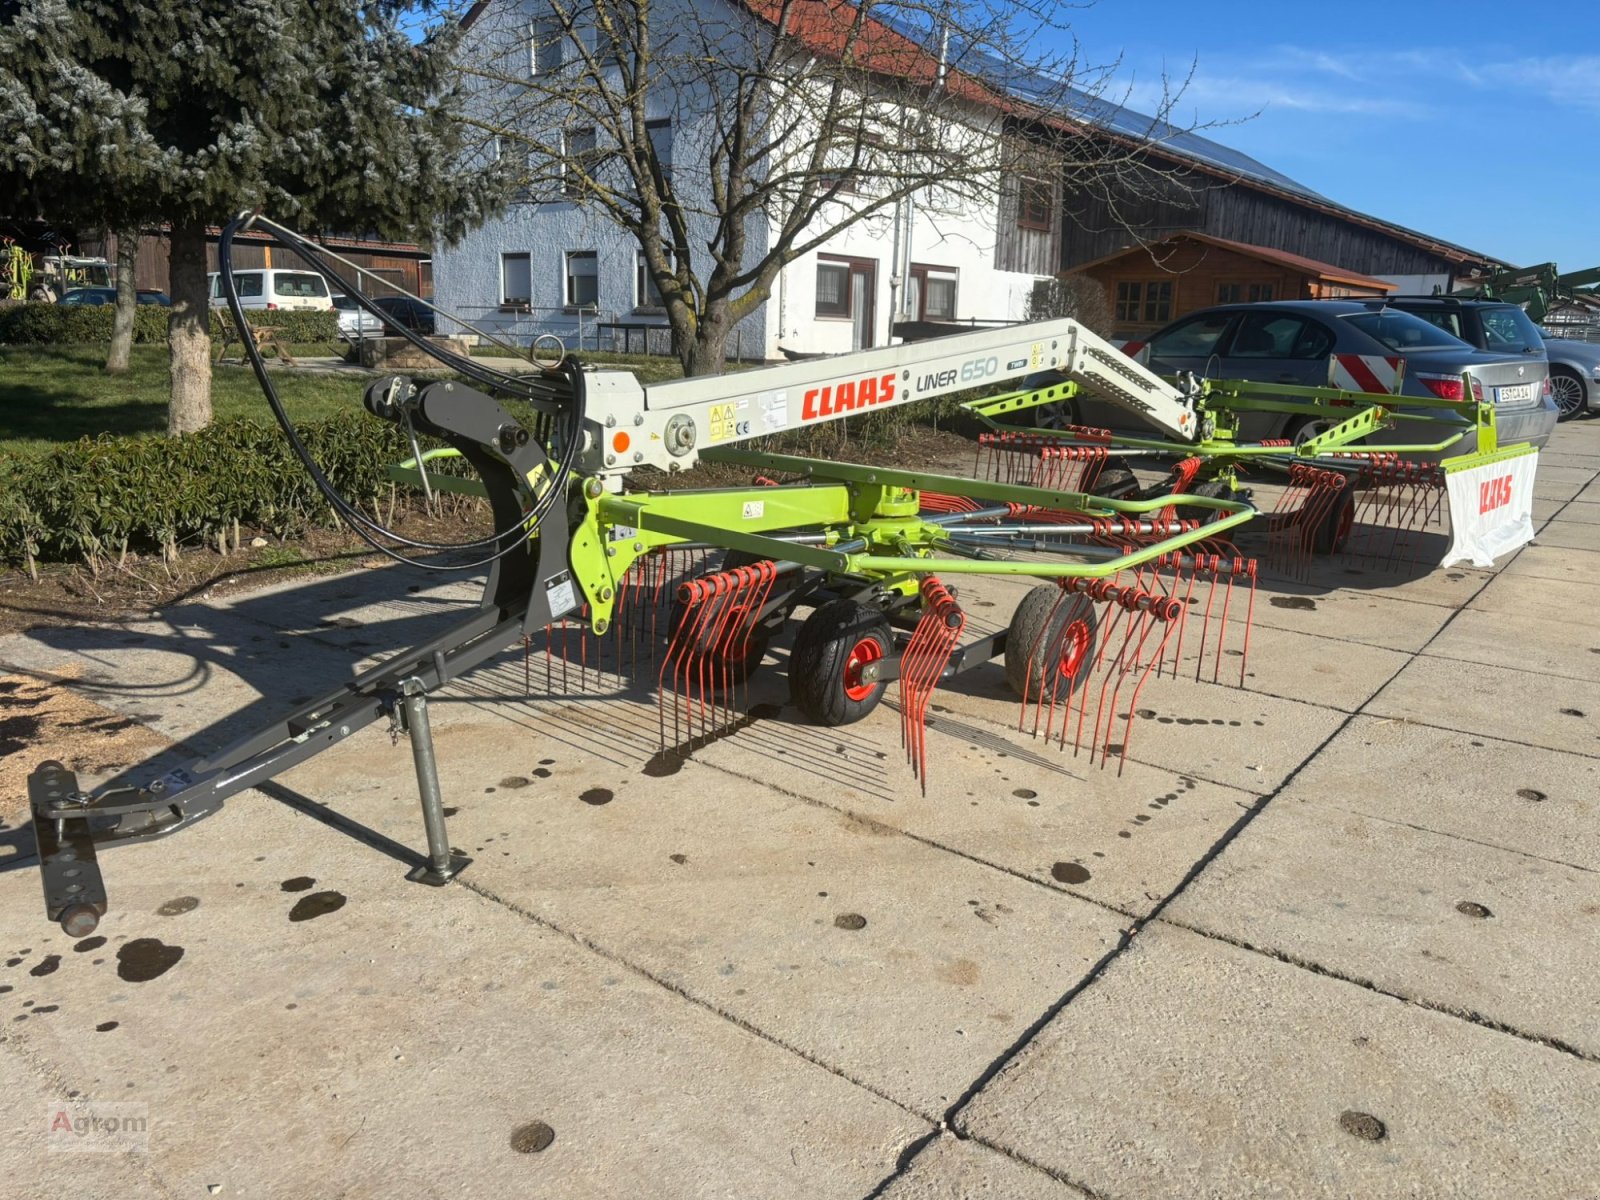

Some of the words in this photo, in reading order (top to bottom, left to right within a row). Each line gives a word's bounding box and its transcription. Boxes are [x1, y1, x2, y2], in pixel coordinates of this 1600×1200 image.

[801, 373, 896, 421] CLAAS
[916, 369, 958, 393] LINER
[961, 356, 998, 382] 650
